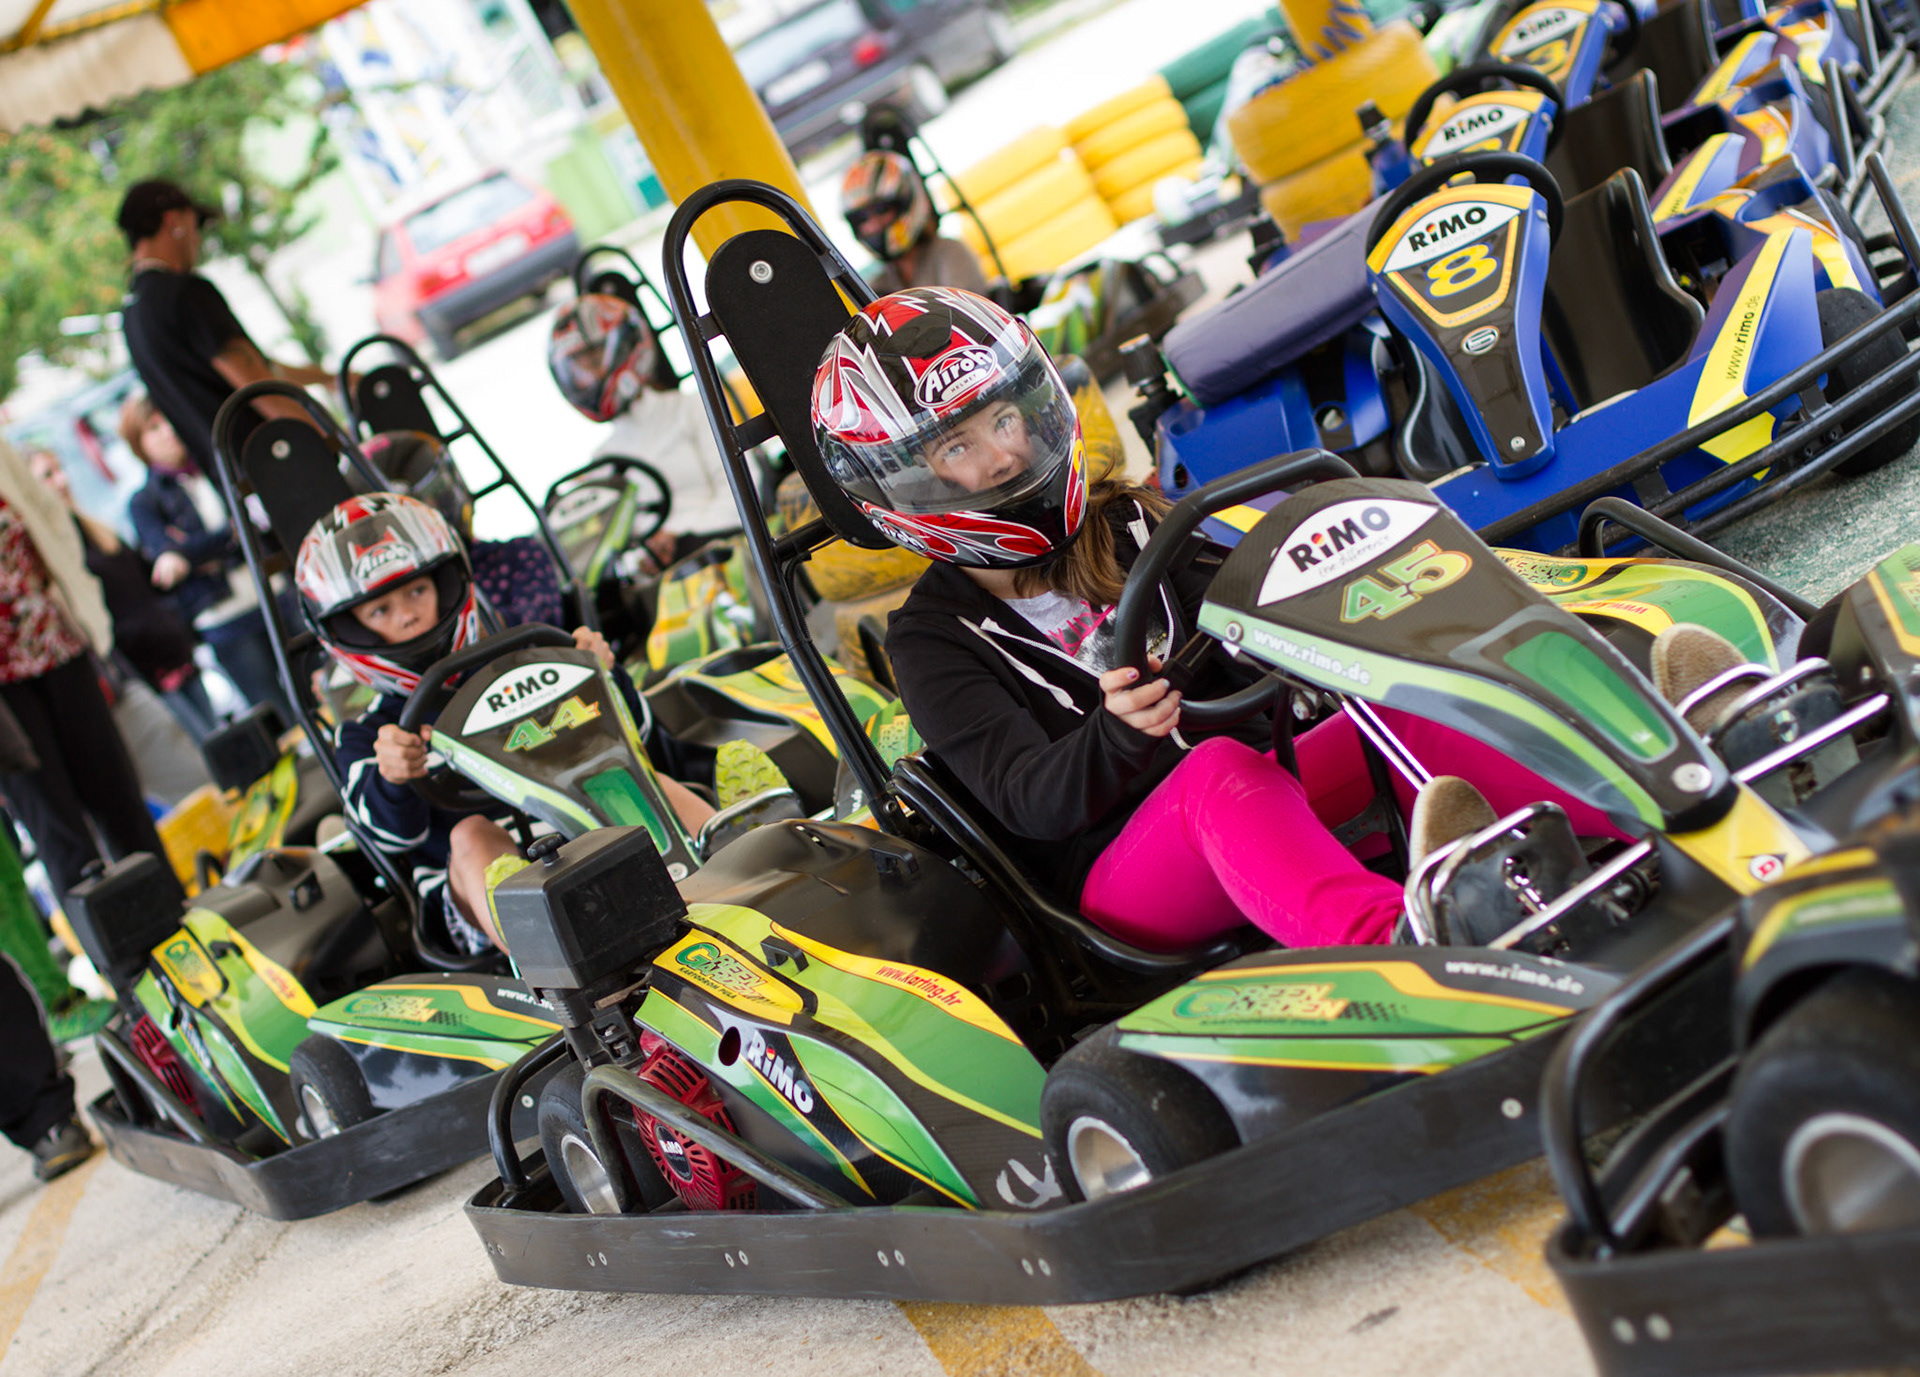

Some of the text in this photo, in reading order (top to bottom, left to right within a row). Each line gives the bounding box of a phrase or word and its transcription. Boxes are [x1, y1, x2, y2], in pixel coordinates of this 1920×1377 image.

[1426, 243, 1500, 298] 8
[1726, 295, 1761, 380] www.rimo.de
[951, 374, 977, 393] HELMET
[1340, 539, 1473, 624] 45
[1253, 627, 1371, 686] www.rimo.de
[503, 695, 601, 752] 44
[875, 965, 963, 1006] www.karting.hr
